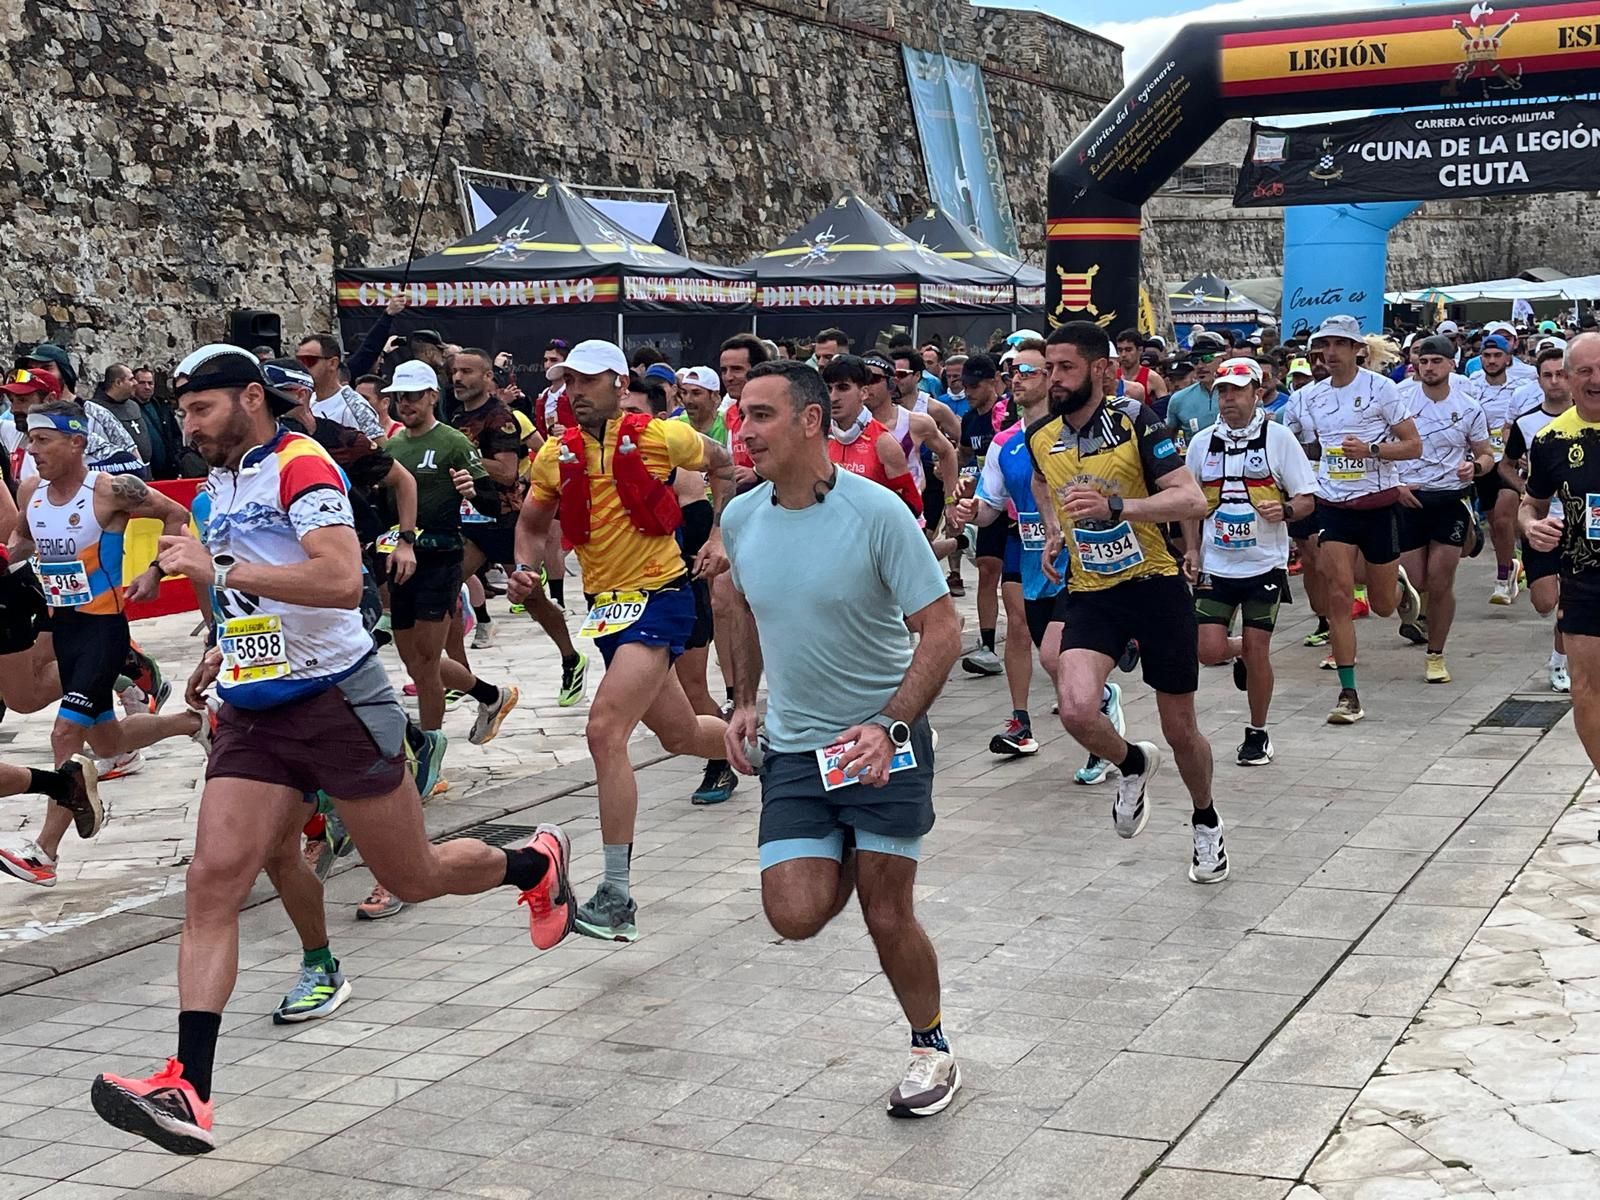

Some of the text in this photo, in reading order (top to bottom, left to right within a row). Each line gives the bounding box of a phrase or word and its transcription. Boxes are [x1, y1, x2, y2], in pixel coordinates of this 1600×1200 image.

[1289, 24, 1600, 72] LEGIÓN ES
[1116, 103, 1128, 124] del
[1415, 111, 1555, 129] CARRERA CÍVICO-MILITAR
[1440, 138, 1470, 157] DE
[1478, 135, 1508, 155] LA
[1438, 161, 1530, 187] CEUTA
[436, 278, 595, 306] DEPORTIVO
[762, 283, 897, 307] DEPORTIVO
[1290, 287, 1367, 310] Ceuta es
[1337, 457, 1364, 469] 5128
[1228, 523, 1251, 536] 948
[1095, 535, 1133, 559] 1394
[55, 574, 79, 589] 916
[605, 603, 642, 620] 4079
[236, 633, 281, 660] 5898
